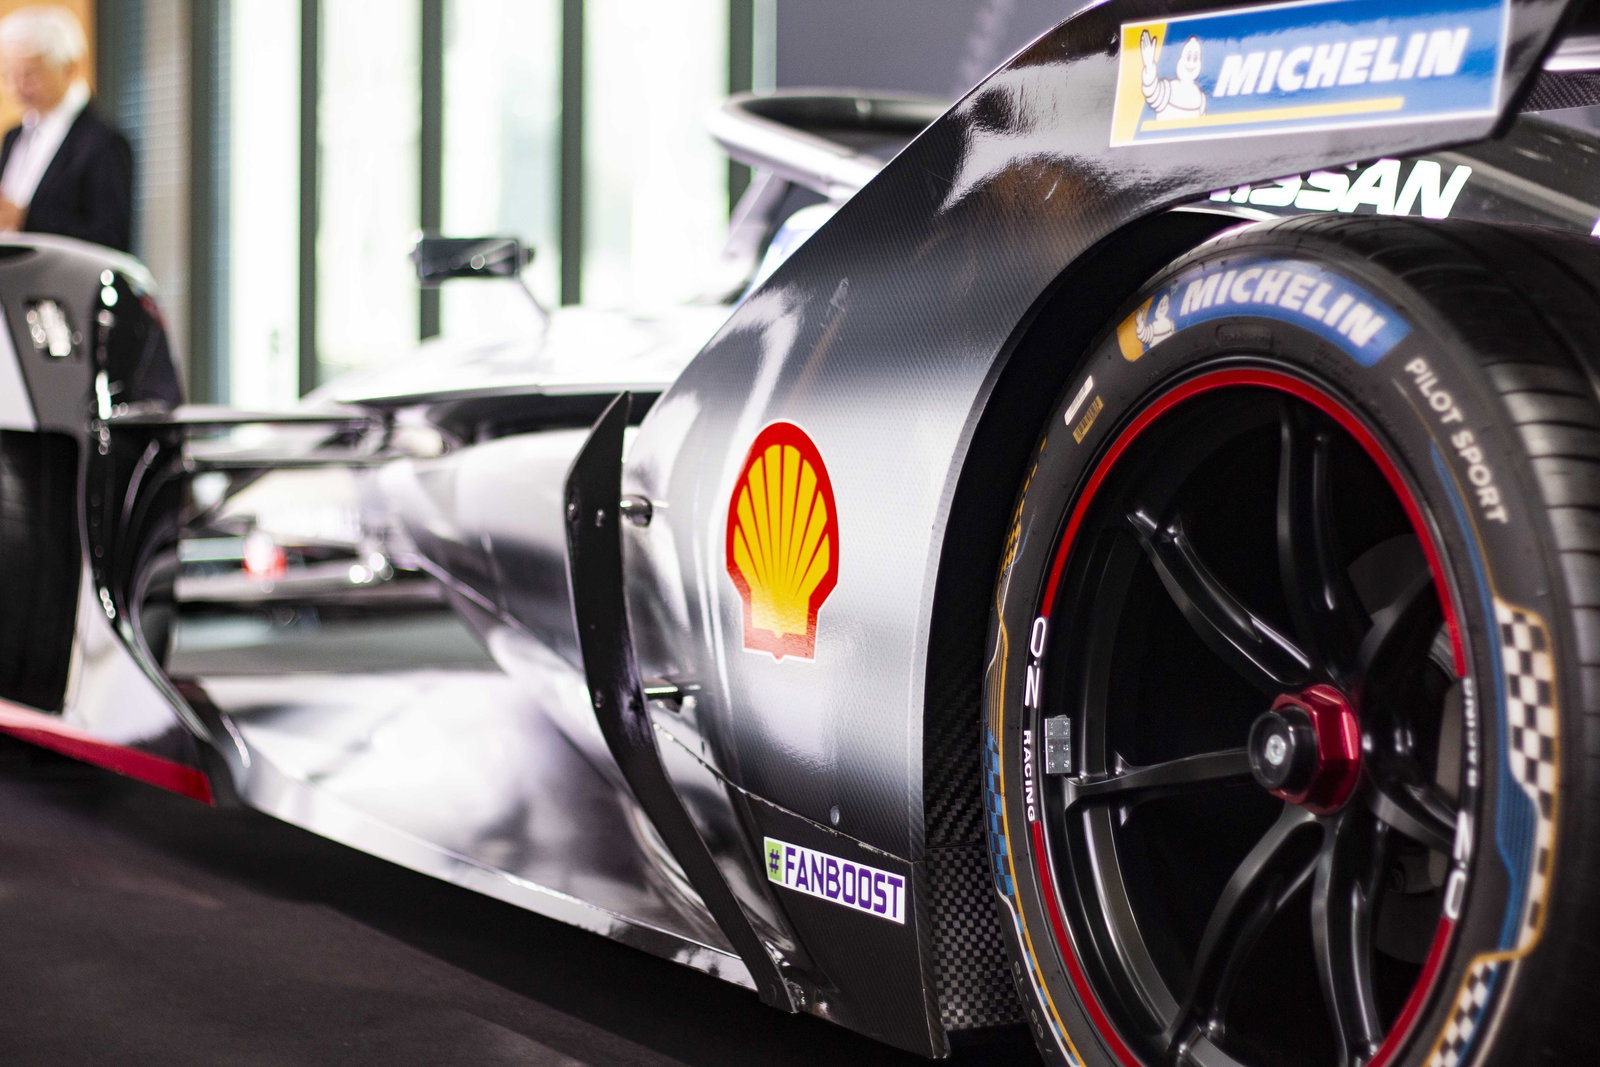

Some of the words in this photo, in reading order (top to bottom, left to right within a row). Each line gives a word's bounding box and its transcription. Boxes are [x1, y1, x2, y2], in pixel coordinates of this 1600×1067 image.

[1213, 28, 1470, 98] MICHELIN
[1179, 267, 1386, 347] MICHELIN
[1404, 357, 1464, 424] PILOT
[1451, 429, 1509, 524] SPORT
[1023, 729, 1036, 822] RACING
[769, 845, 903, 919] #FANBOOST
